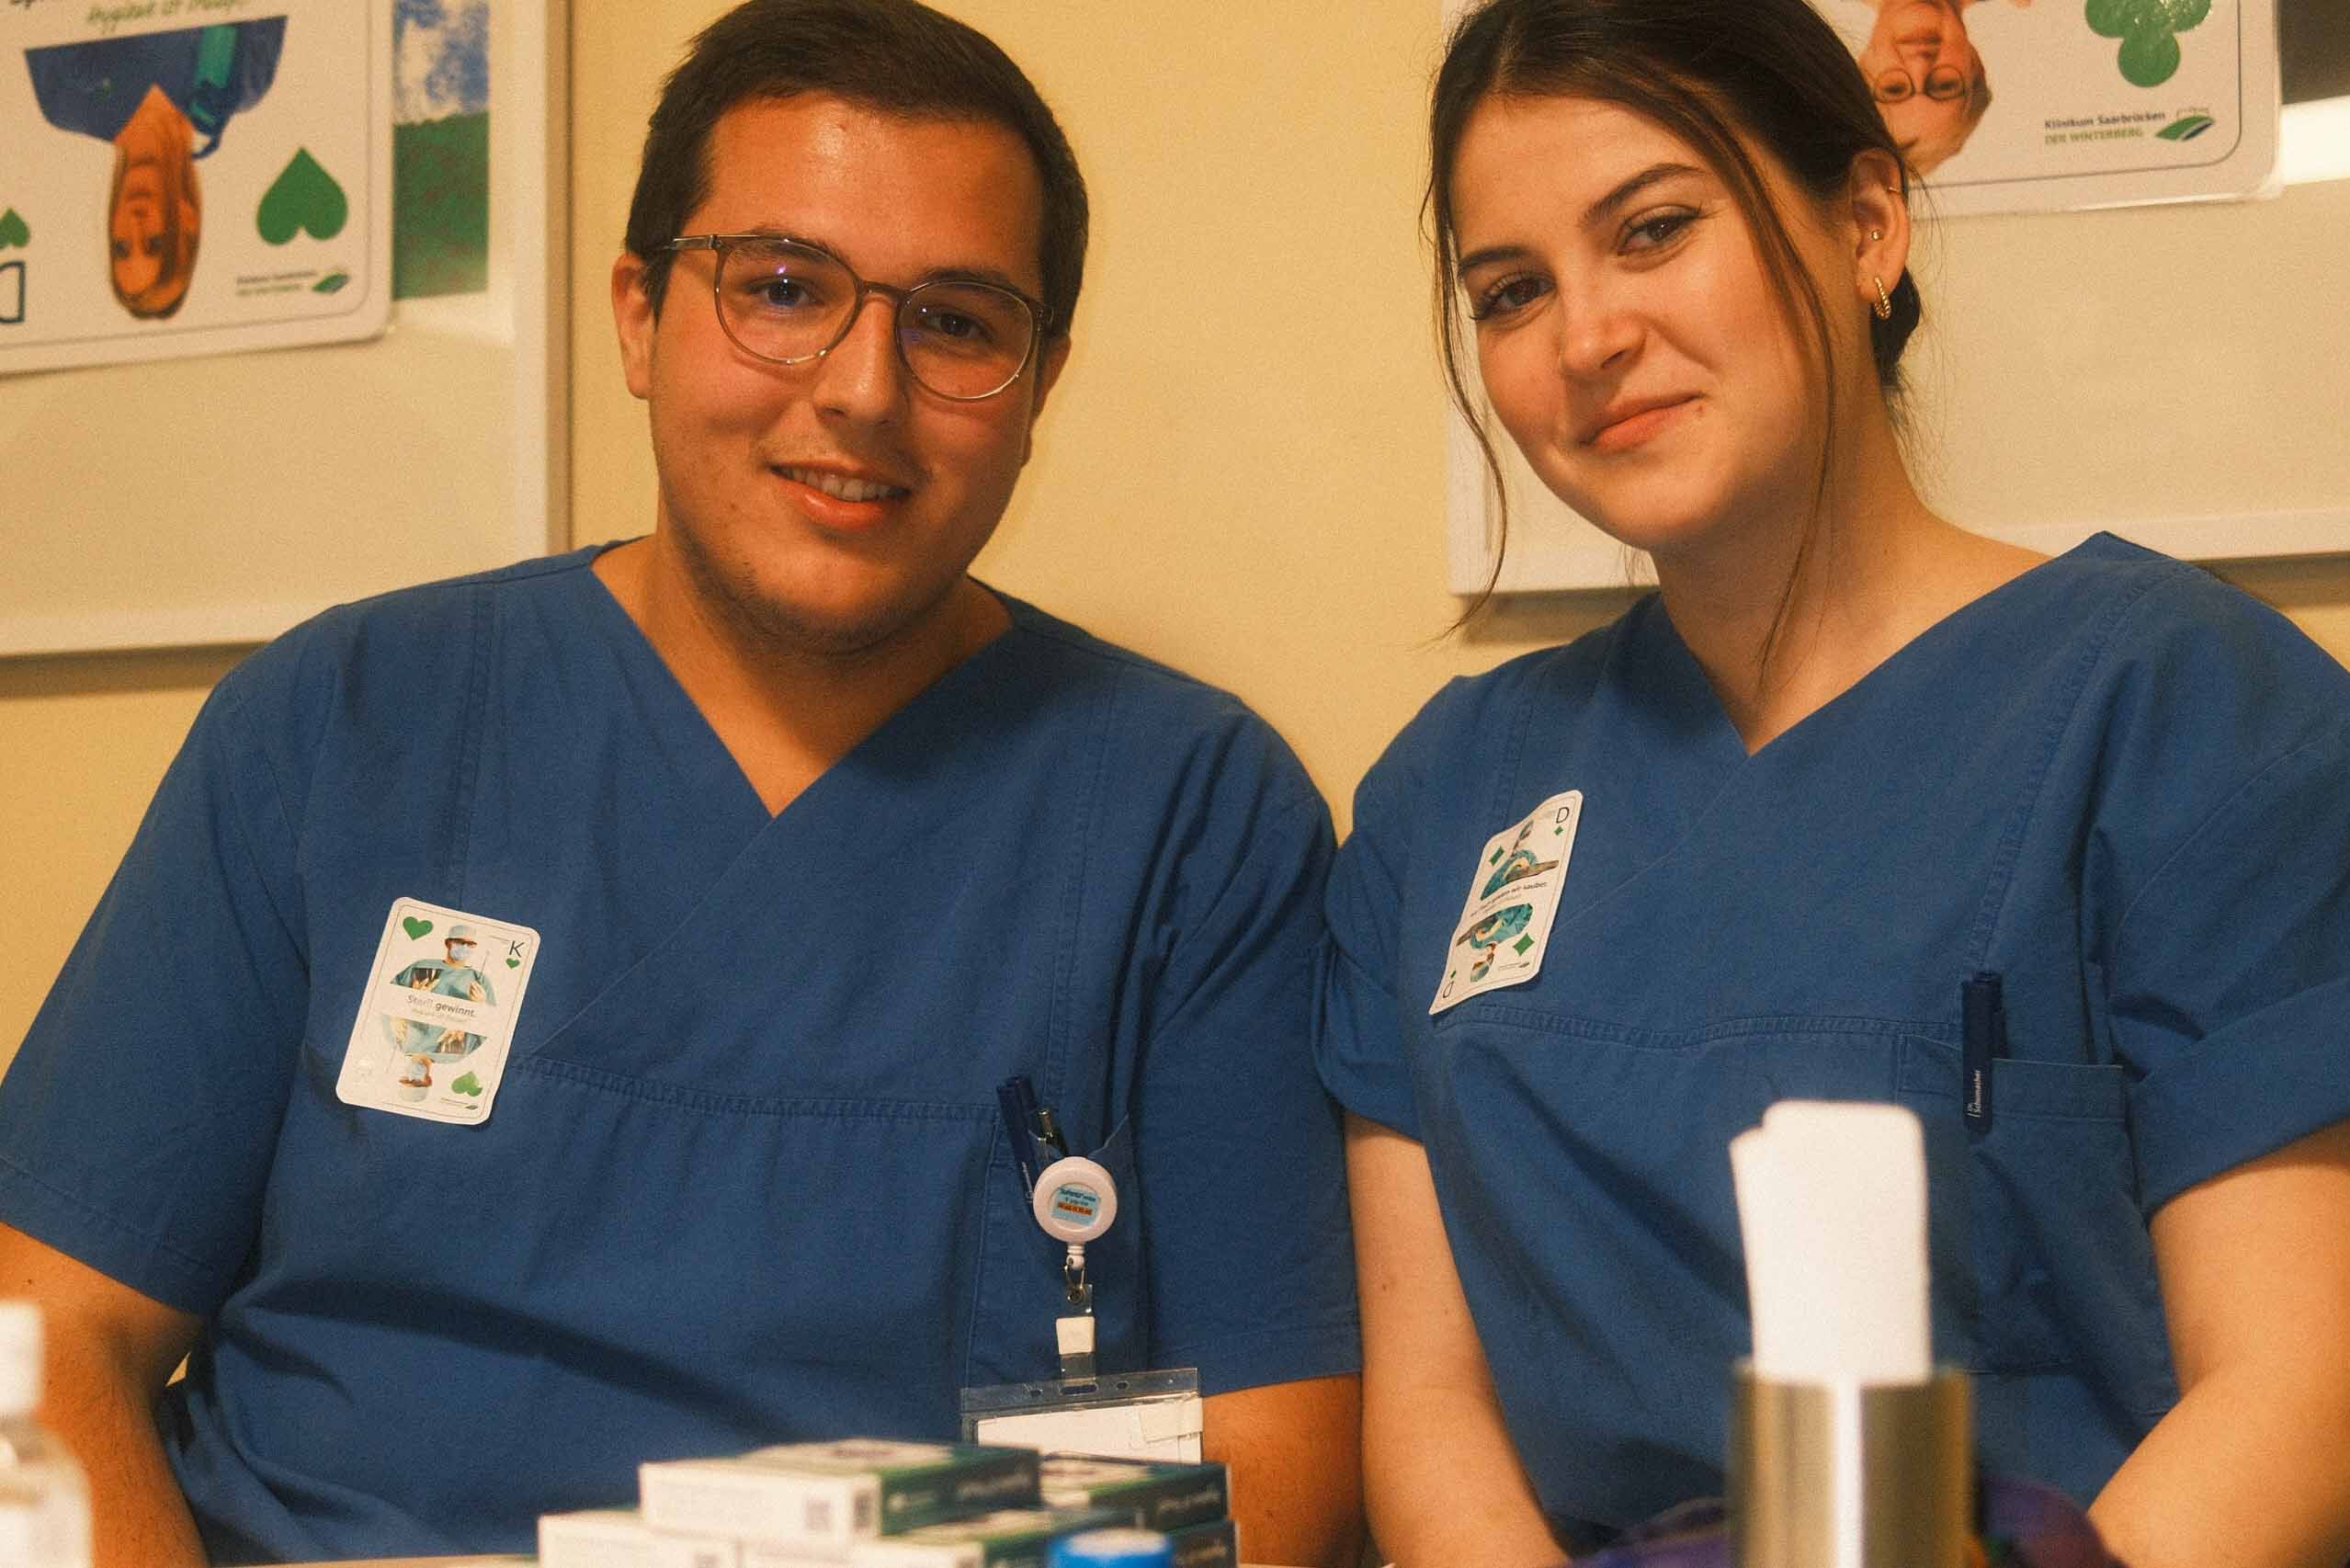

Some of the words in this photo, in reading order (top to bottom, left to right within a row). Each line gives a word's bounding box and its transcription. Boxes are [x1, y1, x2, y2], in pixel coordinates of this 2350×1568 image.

[2044, 118, 2094, 130] Klinikum
[2096, 110, 2166, 125] Saarbrücken
[2070, 128, 2141, 142] WINTERBERG
[1556, 806, 1570, 824] D
[508, 940, 525, 958] K
